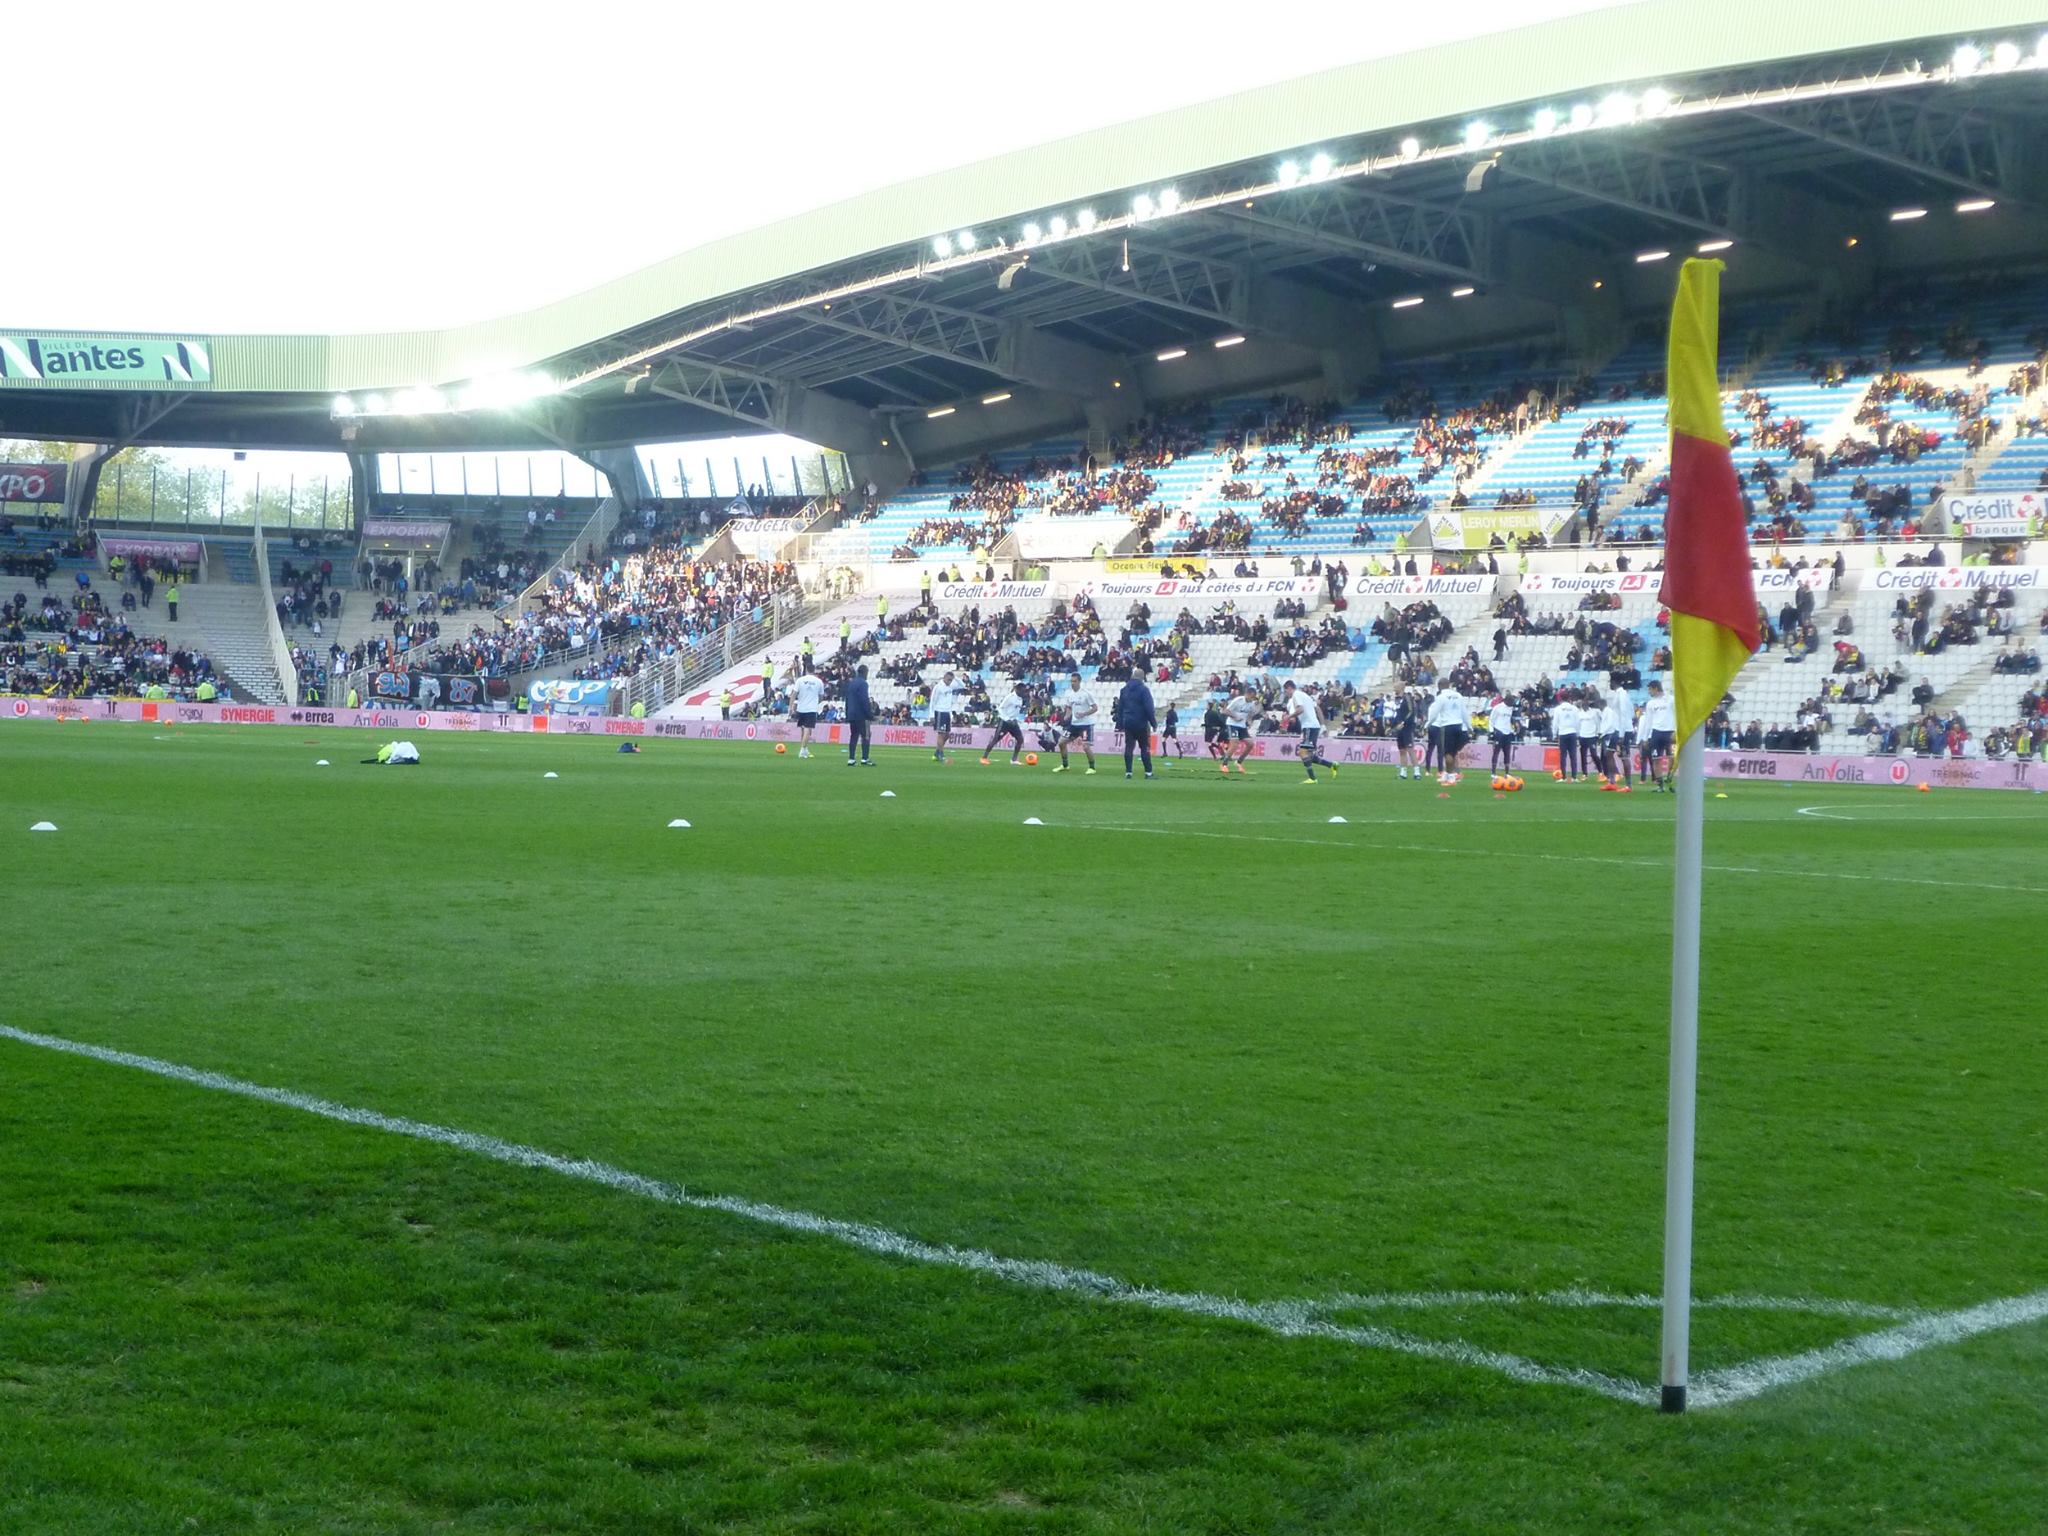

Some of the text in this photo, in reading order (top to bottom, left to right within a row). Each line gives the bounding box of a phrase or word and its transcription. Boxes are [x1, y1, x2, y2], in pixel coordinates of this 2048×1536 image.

[42, 341, 88, 350] VILLE DE
[1950, 499, 2015, 519] Crédit
[1463, 516, 1538, 529] LEROY MERLIN
[1975, 525, 2026, 537] banque
[1551, 577, 1616, 591] Toujours
[1876, 569, 2039, 588] Crédit Mutuel
[943, 583, 1046, 598] Crédit Mutuel
[1101, 583, 1152, 595] Toujours
[1180, 584, 1202, 593] aux
[1206, 582, 1242, 593] côtés
[1266, 581, 1295, 592] FCN
[1356, 578, 1482, 594] Crédit Mutuel
[221, 708, 275, 722] SYNERGIE
[305, 711, 334, 724] errea
[605, 720, 646, 735] SYNERGIE
[885, 730, 926, 744] SYNERGIE
[1739, 758, 1776, 775] errea
